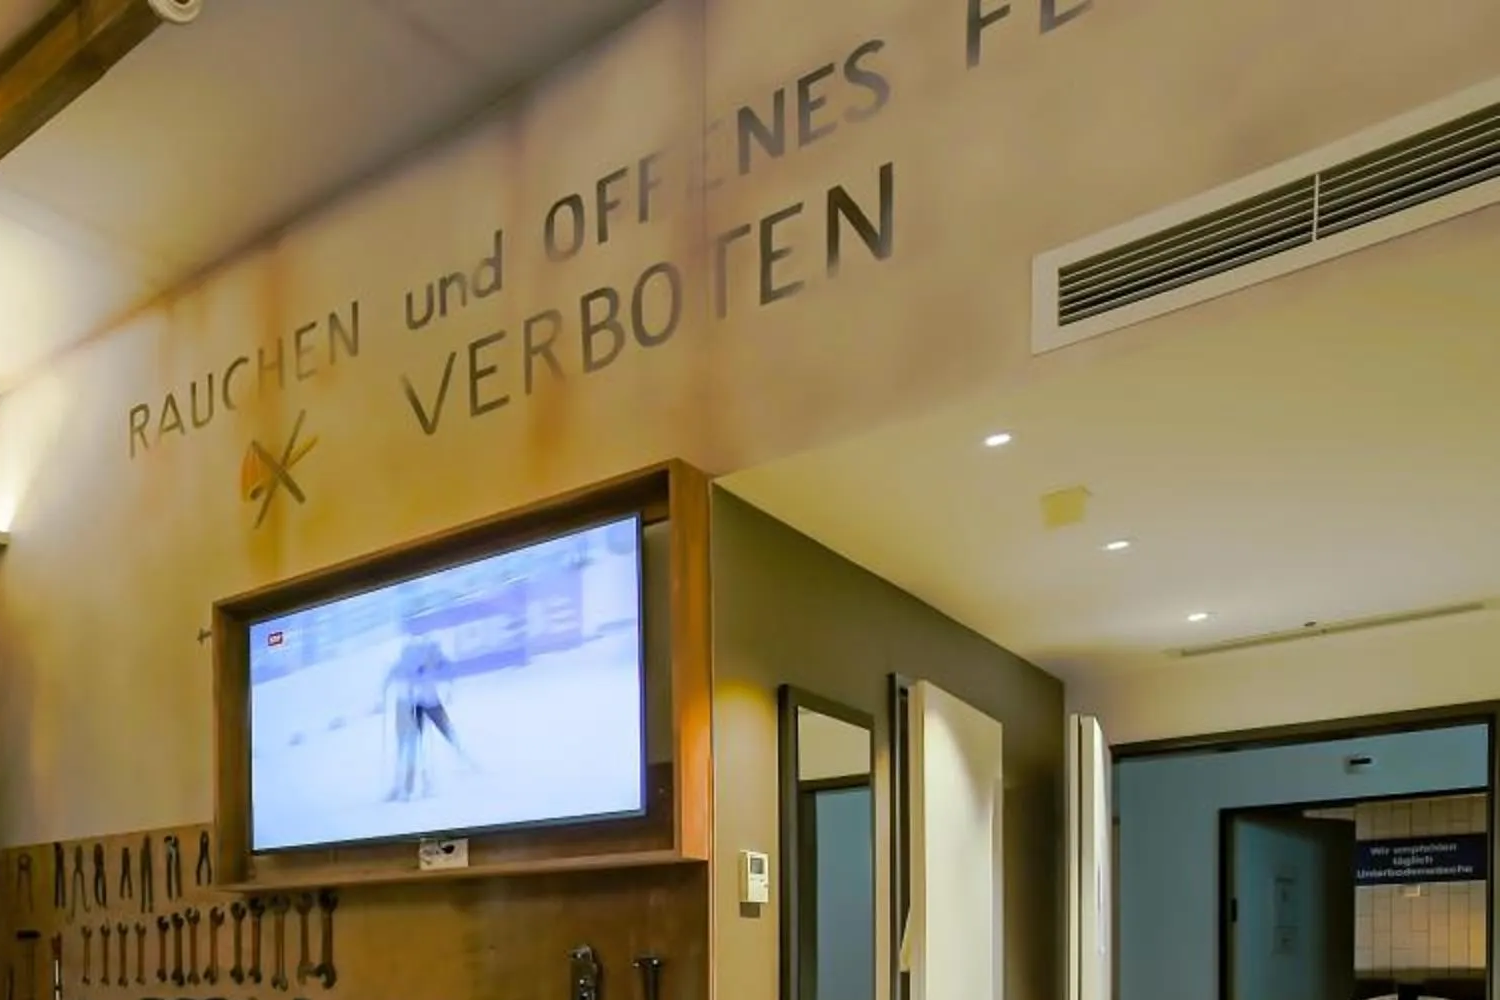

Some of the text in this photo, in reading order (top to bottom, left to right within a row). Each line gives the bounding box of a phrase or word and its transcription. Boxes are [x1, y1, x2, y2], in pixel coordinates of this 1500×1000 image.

[128, 300, 359, 460] RAUCHEN
[404, 229, 503, 331] und
[543, 38, 891, 263] OFFENES
[401, 161, 894, 436] VERBOTEN
